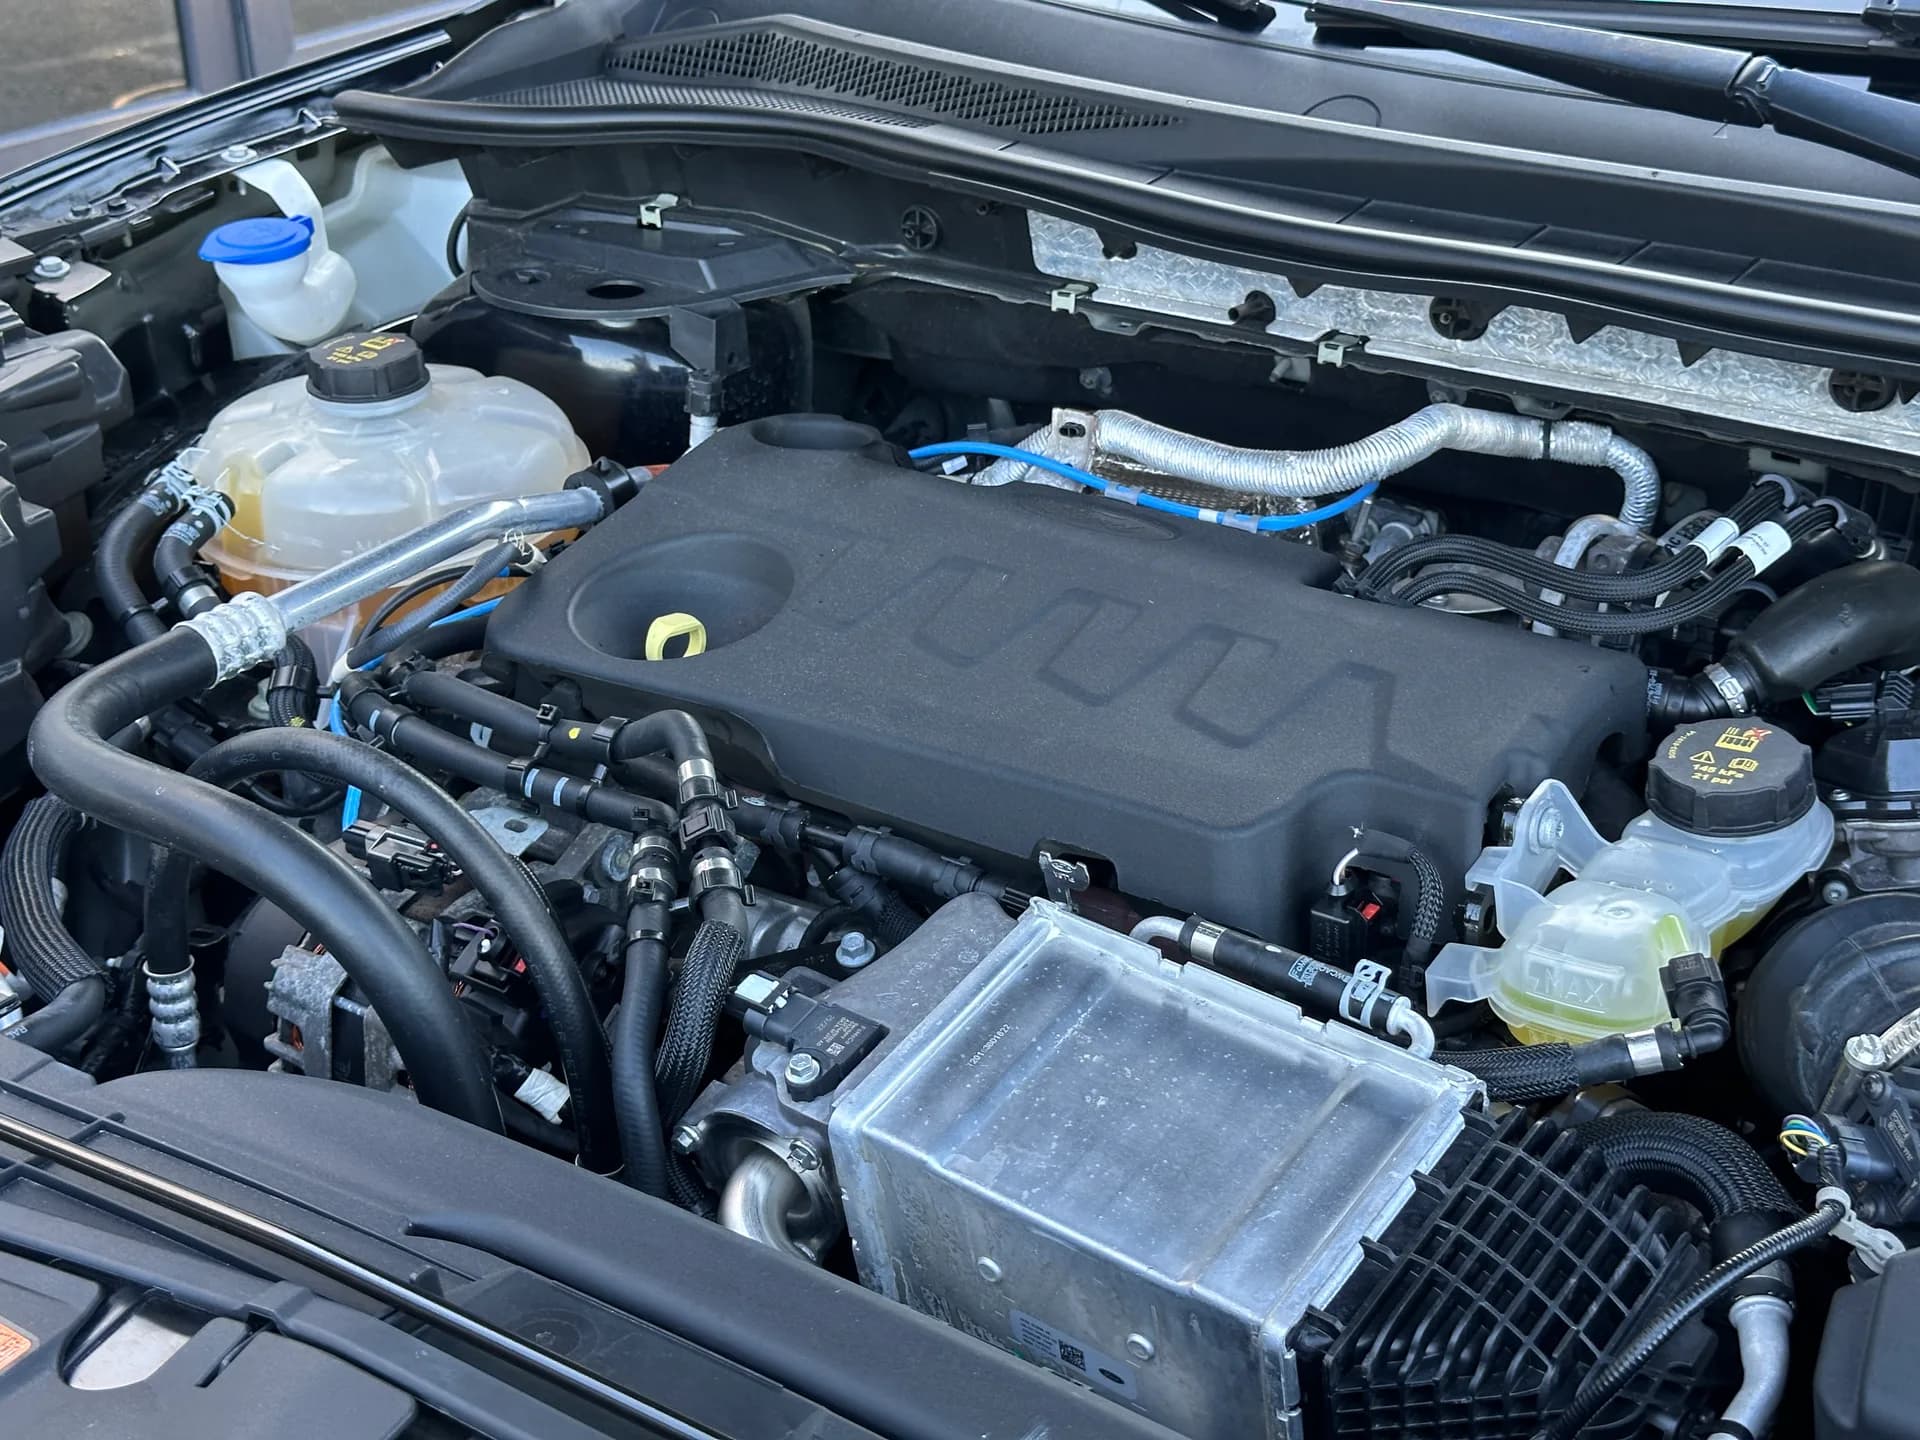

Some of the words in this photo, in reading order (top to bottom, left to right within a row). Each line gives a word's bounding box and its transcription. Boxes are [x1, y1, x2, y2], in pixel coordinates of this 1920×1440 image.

[1691, 772, 1710, 781] 21
[1710, 776, 1734, 785] psi
[1692, 763, 1718, 773] 145
[1718, 768, 1745, 779] kPa
[1544, 967, 1606, 1008] MAX
